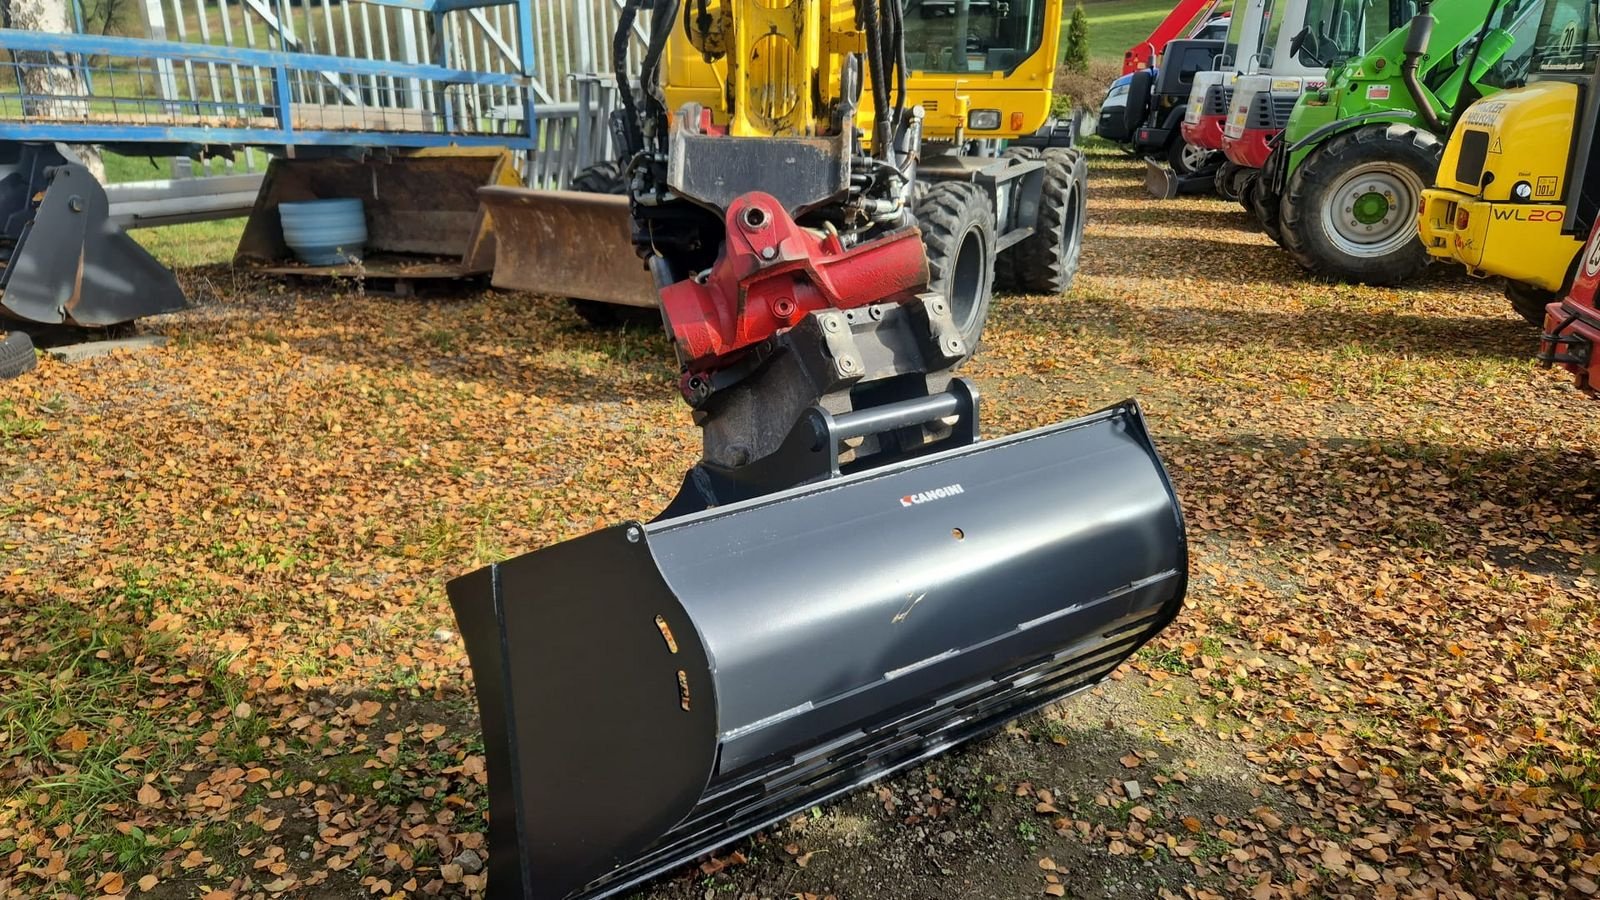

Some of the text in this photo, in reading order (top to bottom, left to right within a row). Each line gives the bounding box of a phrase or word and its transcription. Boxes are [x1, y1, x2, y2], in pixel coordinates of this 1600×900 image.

[1561, 27, 1575, 52] 20
[1538, 184, 1550, 195] 101
[1494, 208, 1564, 222] WL20
[911, 483, 965, 504] CANGINI
